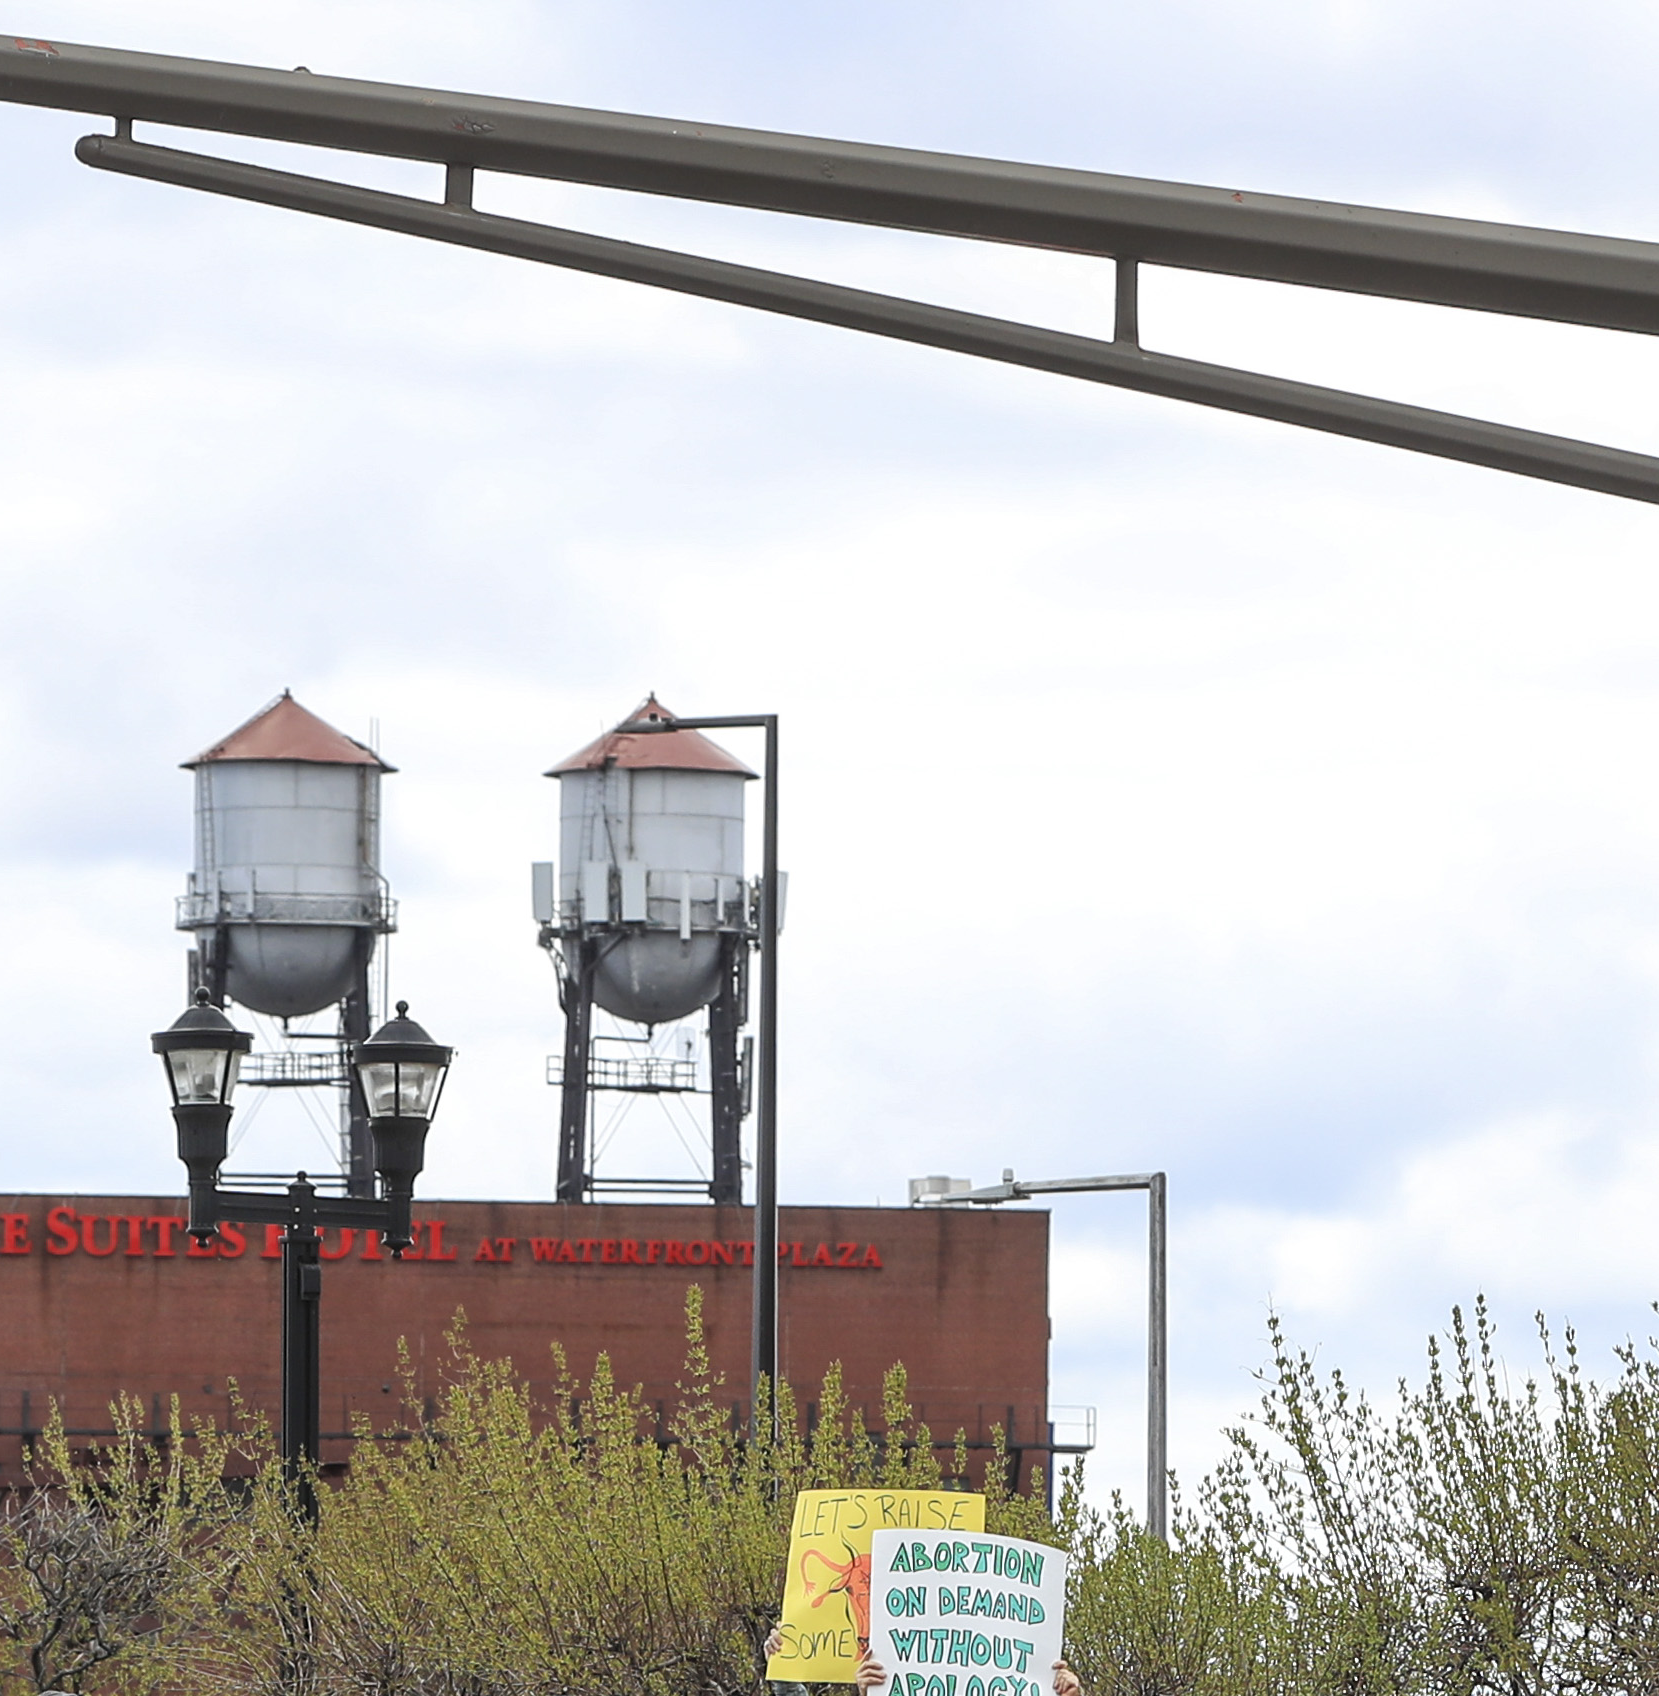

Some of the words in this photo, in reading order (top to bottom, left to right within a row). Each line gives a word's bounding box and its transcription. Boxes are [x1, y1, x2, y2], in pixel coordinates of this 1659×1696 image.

[473, 1237, 516, 1262] AT
[530, 1238, 755, 1265] WATERFRONT
[800, 1494, 868, 1538] LET'S
[874, 1495, 970, 1530] RAISE
[890, 1542, 1045, 1587] ABORTION
[886, 1586, 926, 1617] ON
[939, 1586, 1045, 1625] DEMAND
[779, 1624, 852, 1660] SOME
[889, 1628, 1033, 1673] WITHOUT
